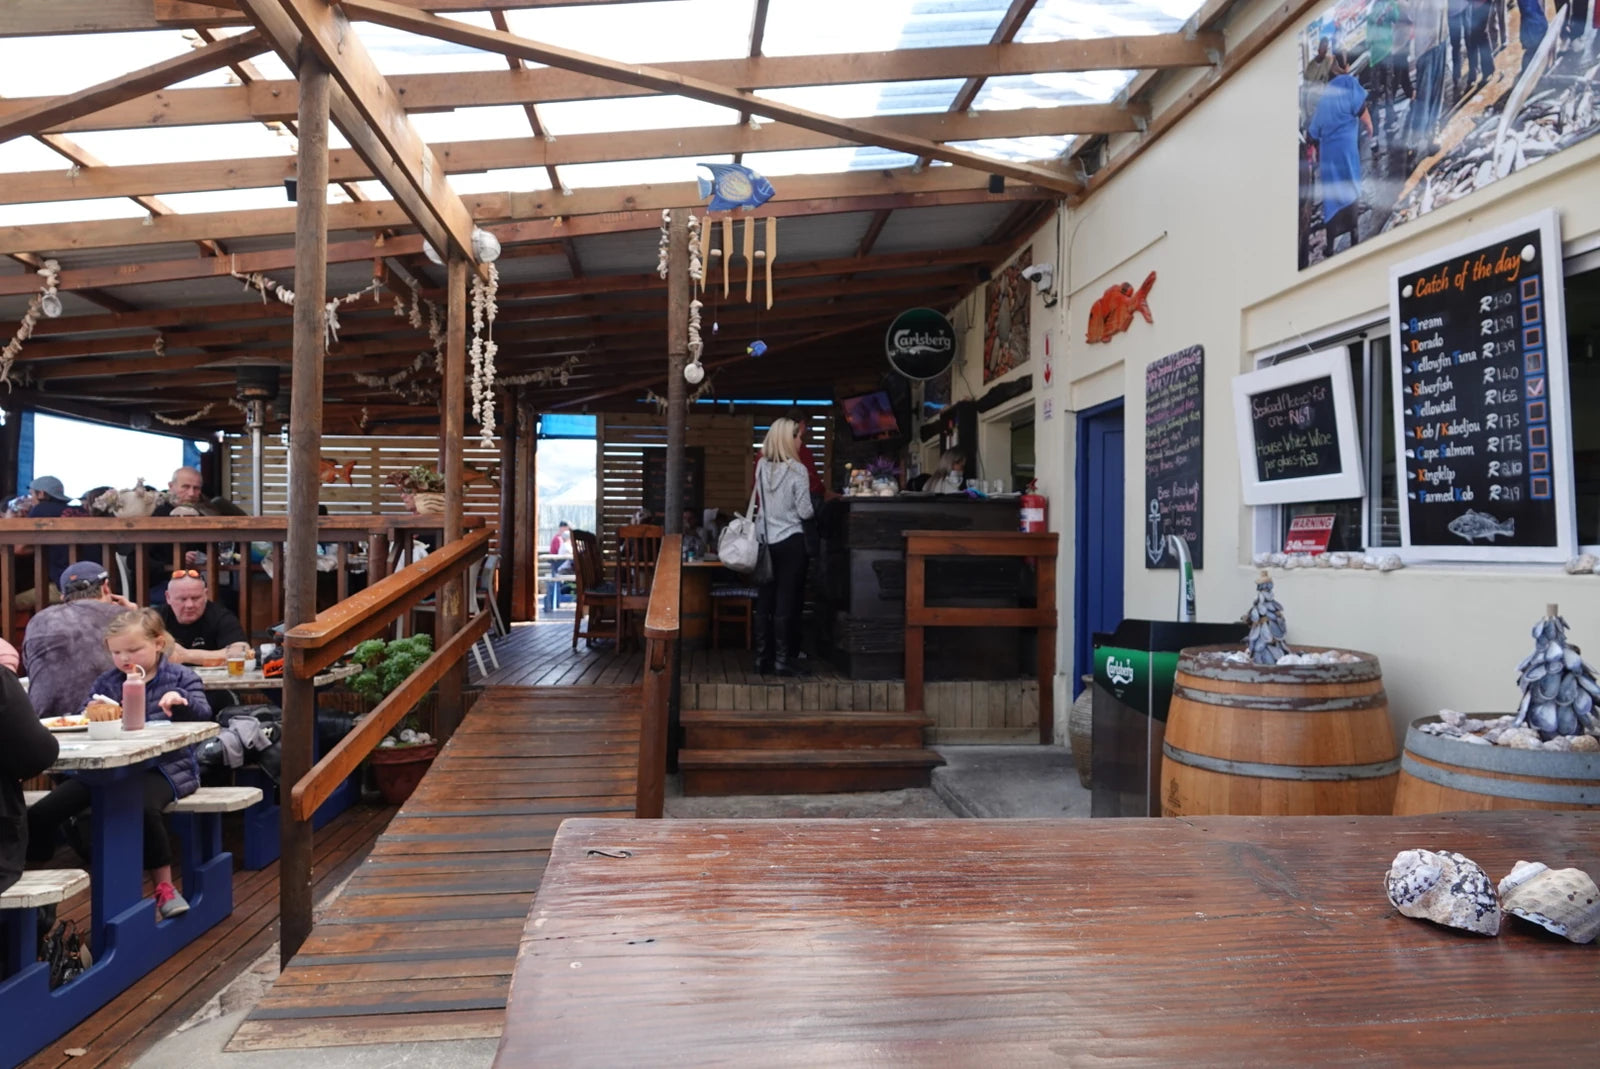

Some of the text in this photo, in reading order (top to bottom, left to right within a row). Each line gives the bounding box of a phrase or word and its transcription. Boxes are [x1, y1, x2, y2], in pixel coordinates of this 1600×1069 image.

[1416, 246, 1521, 297] Catch of the day
[1409, 317, 1443, 333] Bream
[894, 329, 951, 351] Carlsberg
[1410, 332, 1444, 353] Dorado
[1411, 352, 1452, 374] Yellowfin
[1452, 350, 1477, 366] Tuna
[1412, 375, 1453, 397] Silverfish
[1414, 388, 1518, 416] Yellowtail R165
[1415, 422, 1434, 439] Kob
[1441, 417, 1481, 438] Kabeljou
[1486, 413, 1520, 430] R175
[1416, 434, 1522, 463] Cape Salmon R175
[1416, 465, 1456, 485] Kingklip
[1418, 486, 1455, 503] Farmed
[1455, 485, 1474, 502] Kob
[1293, 517, 1331, 528] WARNING
[1106, 656, 1134, 683] Carlsberg
